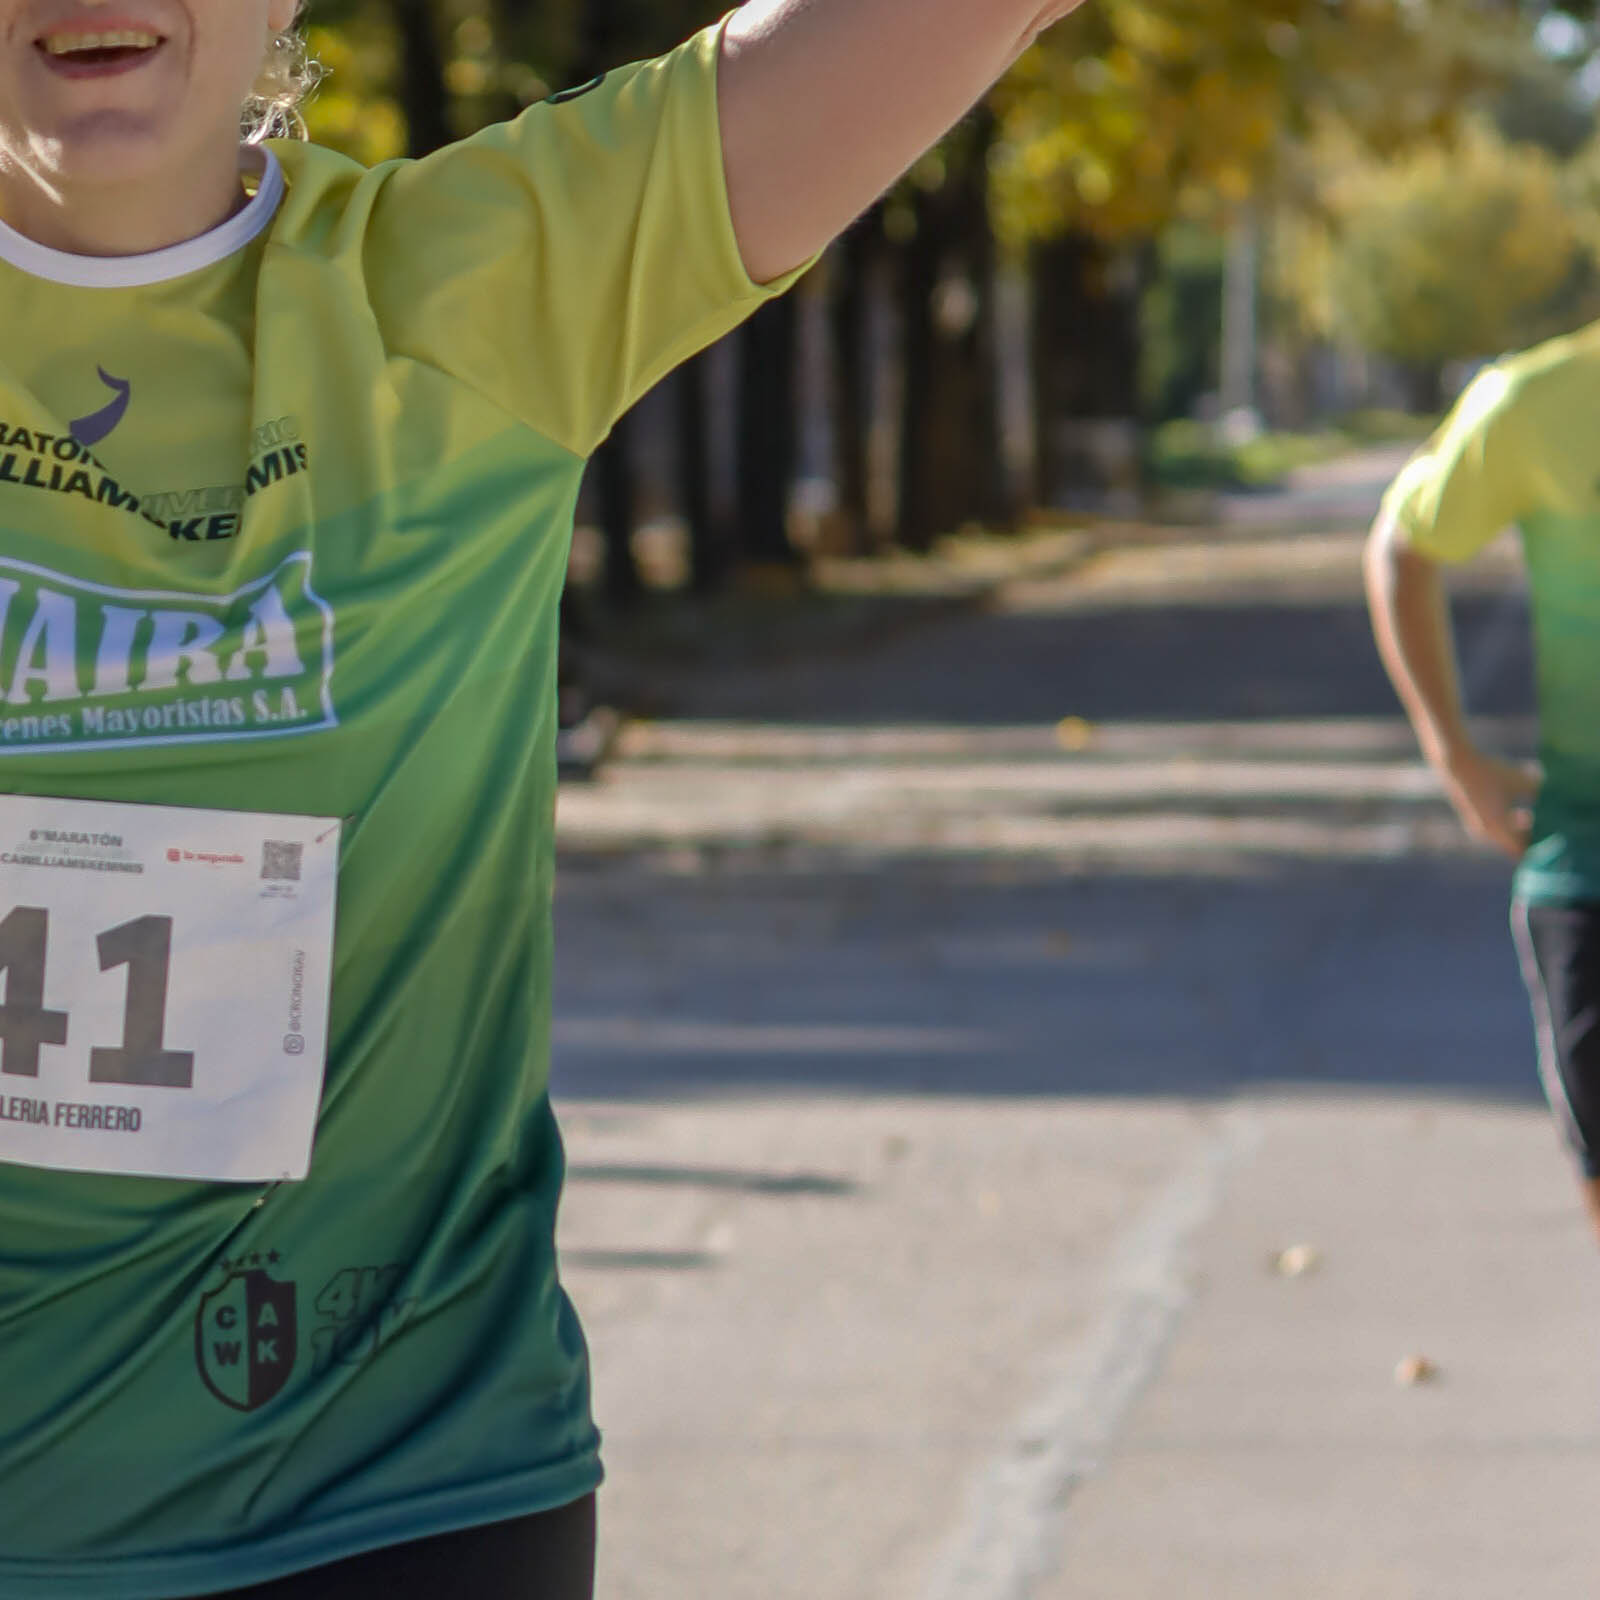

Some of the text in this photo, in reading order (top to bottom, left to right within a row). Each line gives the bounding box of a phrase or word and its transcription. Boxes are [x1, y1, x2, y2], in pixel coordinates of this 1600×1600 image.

[82, 697, 245, 735] Mayoristas
[253, 686, 308, 723] S.A.
[53, 1102, 142, 1132] FERRERO
[215, 1302, 280, 1330] C A
[213, 1339, 279, 1366] W K
